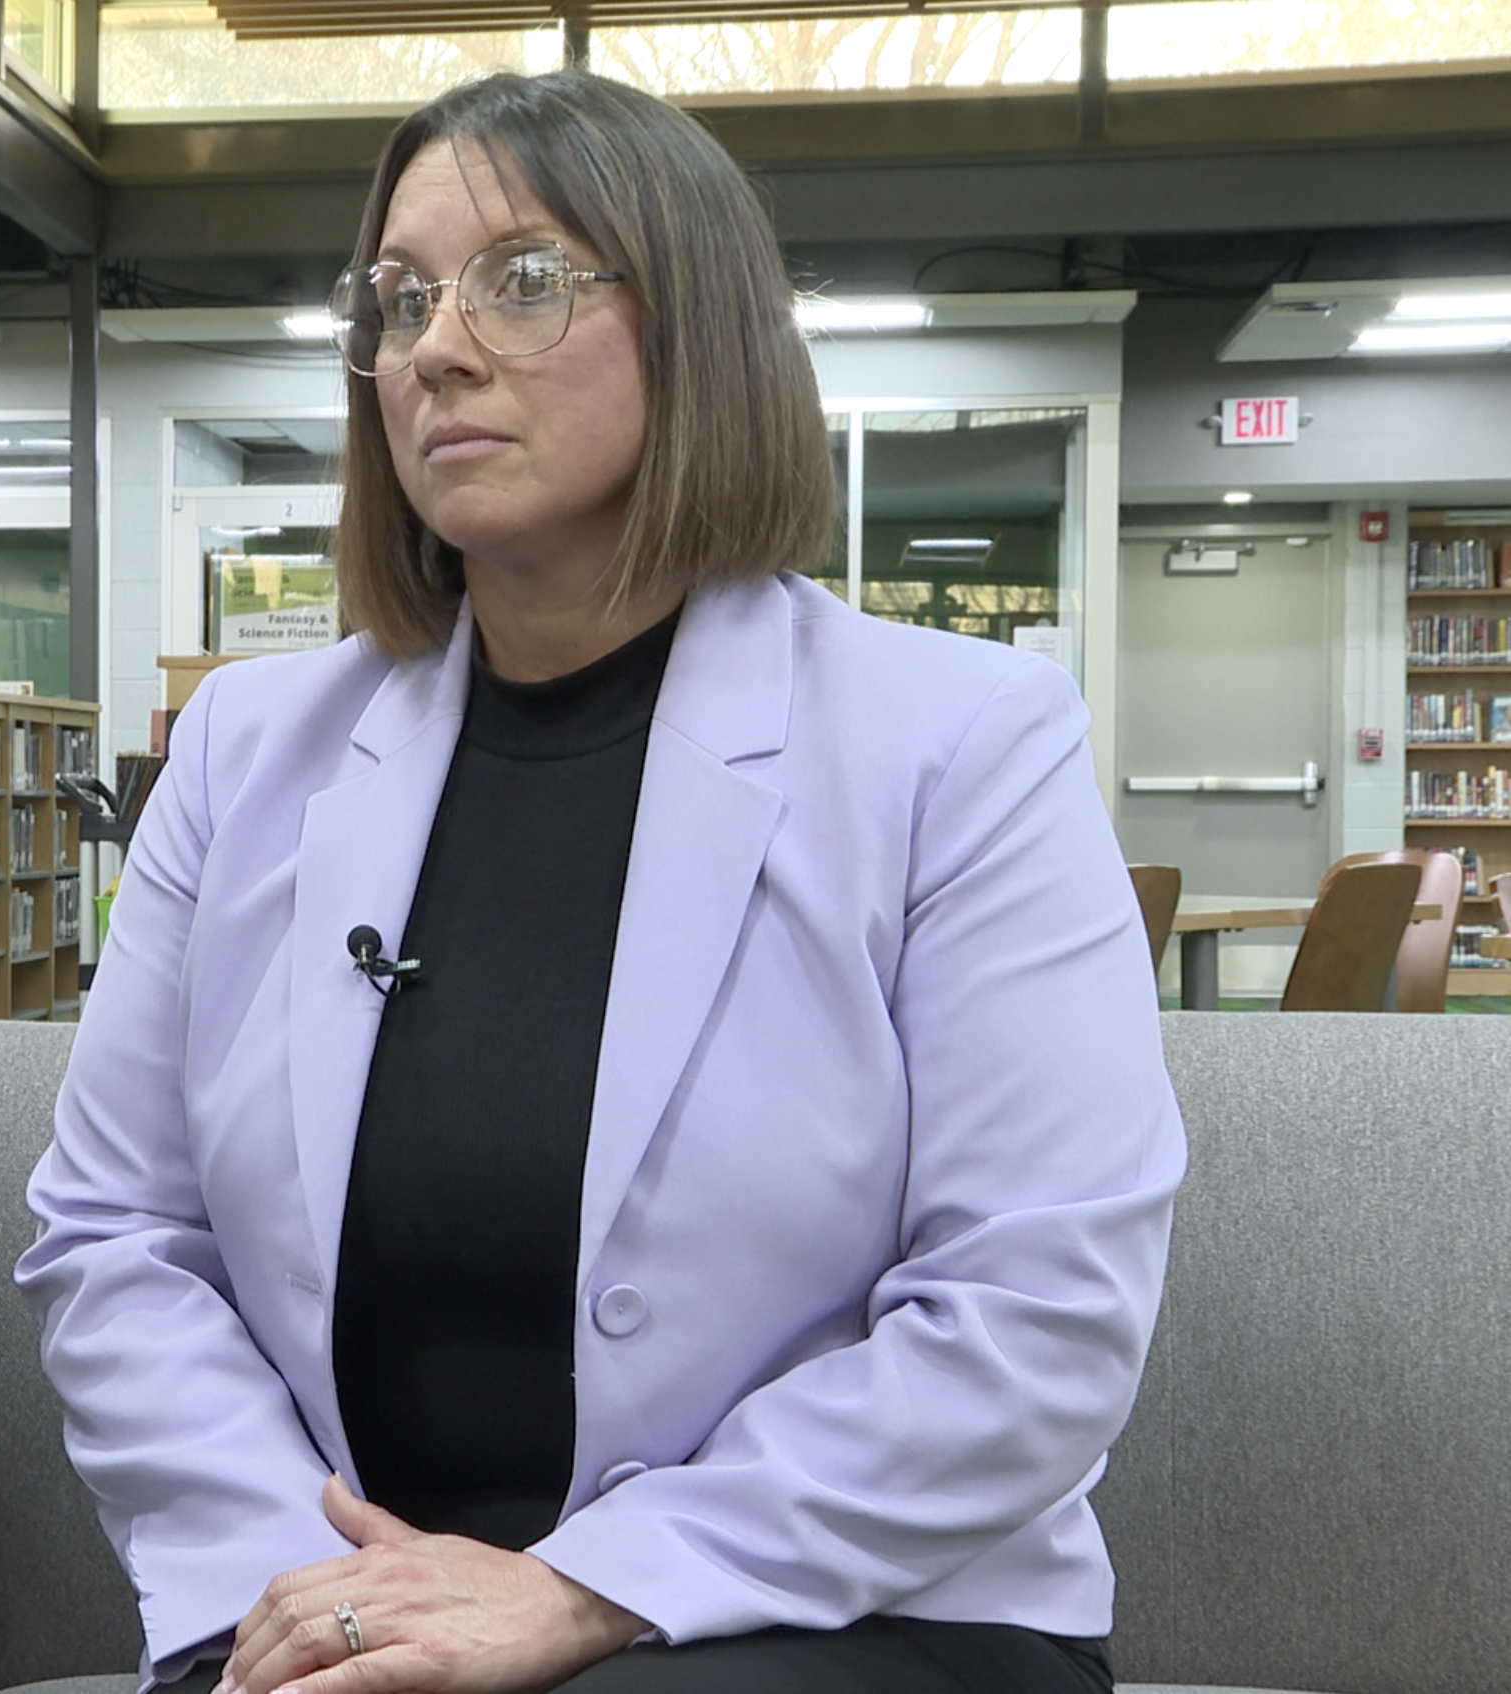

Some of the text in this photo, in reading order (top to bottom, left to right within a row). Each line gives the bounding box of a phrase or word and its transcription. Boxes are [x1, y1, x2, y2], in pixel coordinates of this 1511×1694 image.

[1236, 400, 1287, 438] EXIT
[285, 502, 293, 517] 2
[268, 614, 329, 625] Fantasy &
[239, 628, 329, 638] Science Fiction
